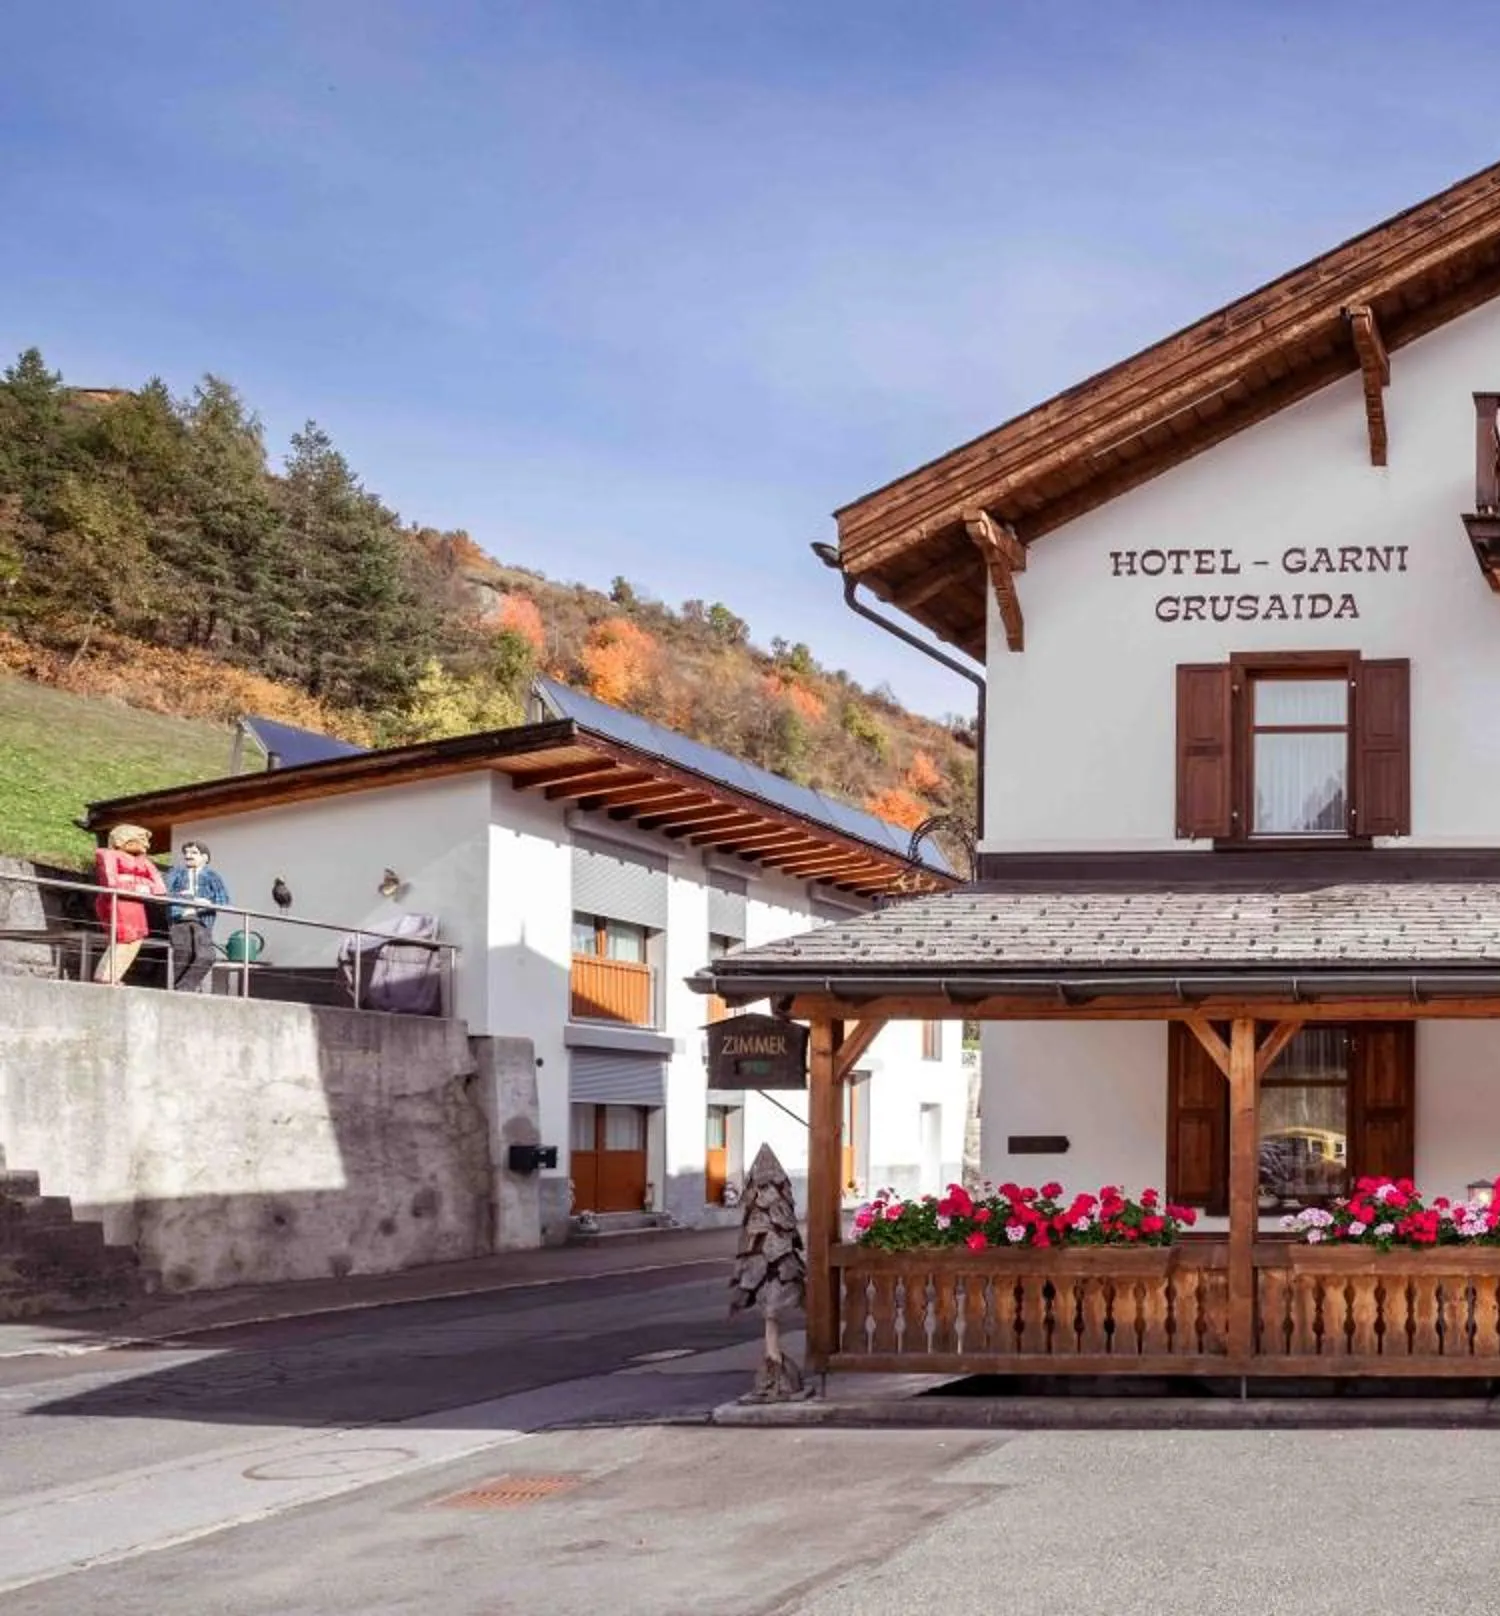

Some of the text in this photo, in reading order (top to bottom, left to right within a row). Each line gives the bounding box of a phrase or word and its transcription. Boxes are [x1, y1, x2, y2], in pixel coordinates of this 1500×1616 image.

[1110, 550, 1241, 576] HOTEL
[1282, 546, 1409, 573] GARNI
[1155, 593, 1360, 622] GRUSAIDA
[721, 1035, 788, 1055] ZIMMER
